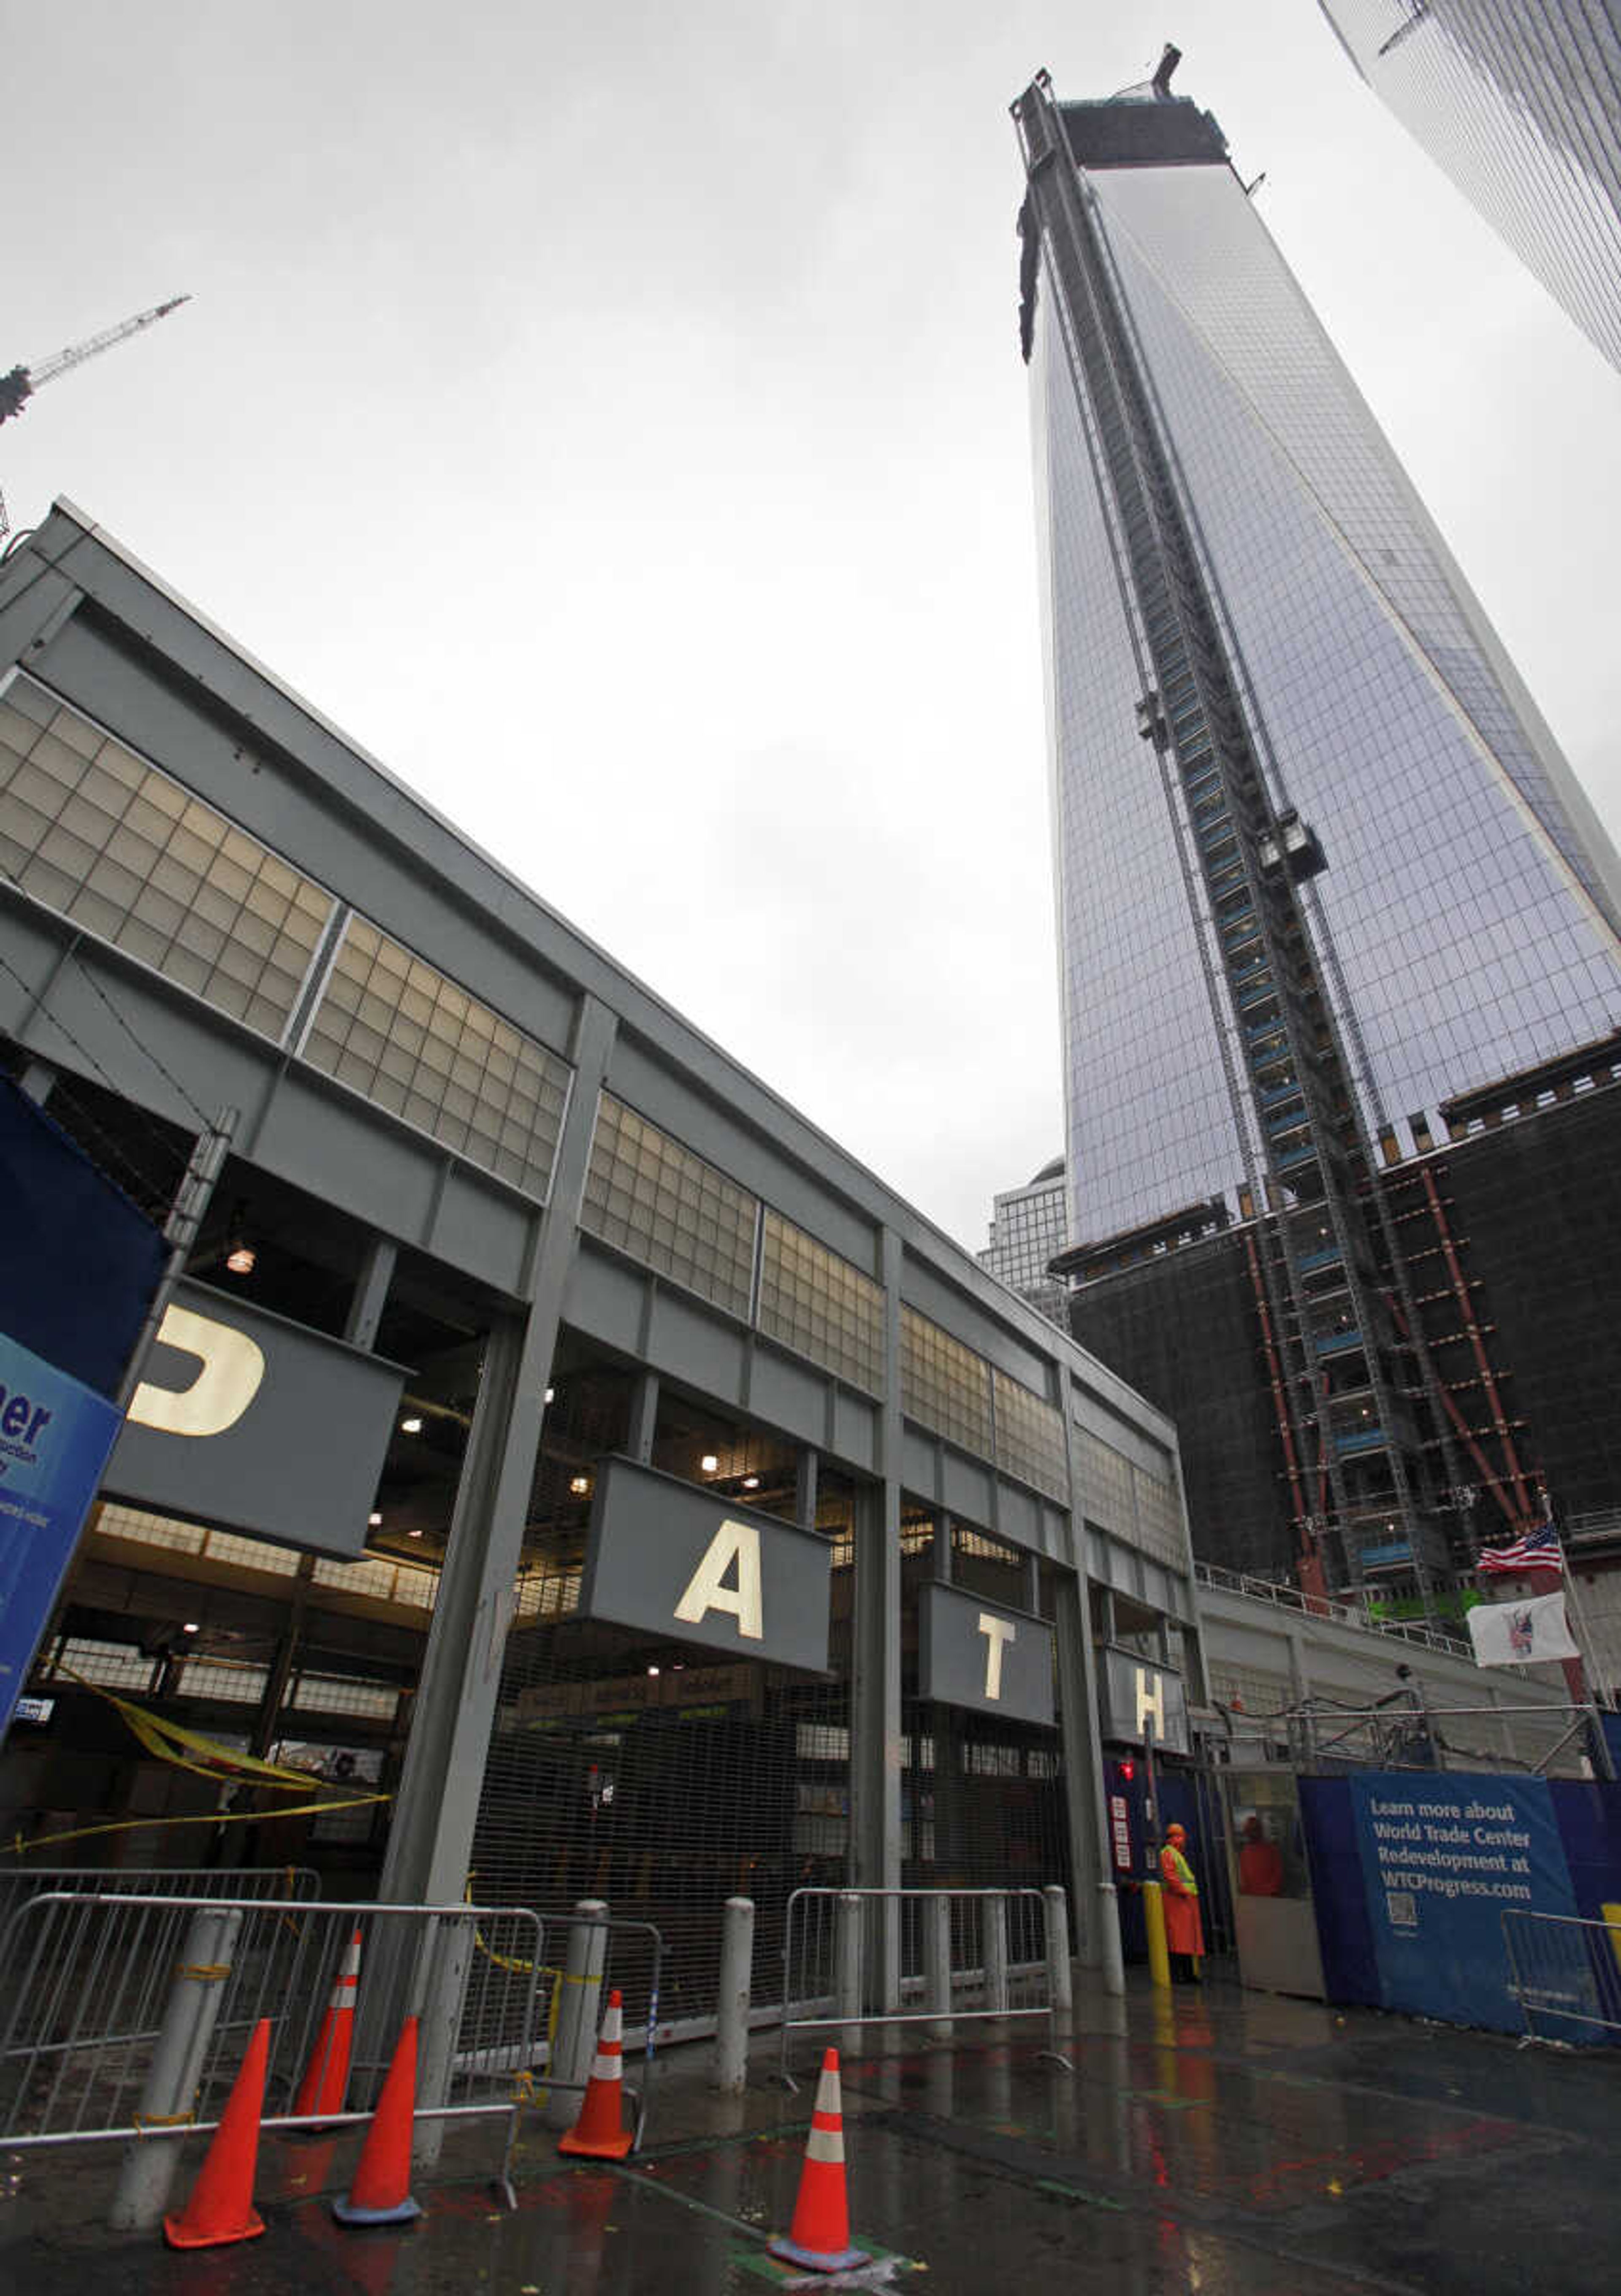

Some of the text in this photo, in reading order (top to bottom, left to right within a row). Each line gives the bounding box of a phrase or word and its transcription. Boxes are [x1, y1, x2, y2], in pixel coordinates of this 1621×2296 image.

[673, 1519, 762, 1639] A
[978, 1613, 1016, 1700] T
[1136, 1668, 1164, 1740] H
[1371, 1797, 1515, 1822] Learn more about
[1373, 1822, 1530, 1847] World Trade Center
[1377, 1846, 1531, 1873] Redevelopment at
[1382, 1871, 1531, 1899] WTCProgress.com
